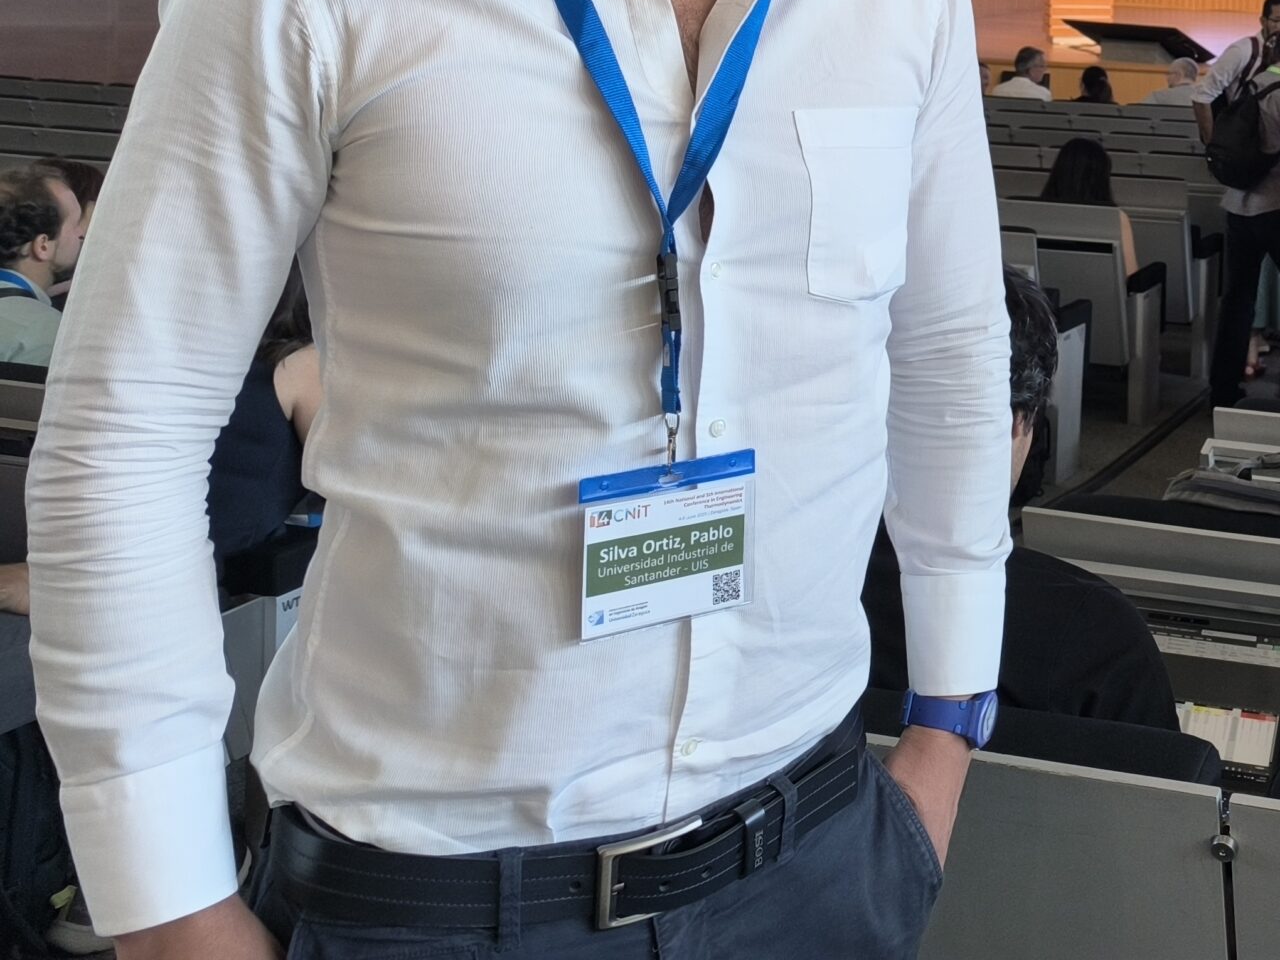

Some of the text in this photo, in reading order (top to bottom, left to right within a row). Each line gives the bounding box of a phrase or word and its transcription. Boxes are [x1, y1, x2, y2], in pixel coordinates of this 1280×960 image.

[598, 541, 734, 578] Universidad Industrial de
[600, 525, 733, 563] Silva Ortiz, Pablo
[624, 566, 681, 586] Santander
[691, 559, 709, 572] UIS
[282, 595, 301, 612] WT
